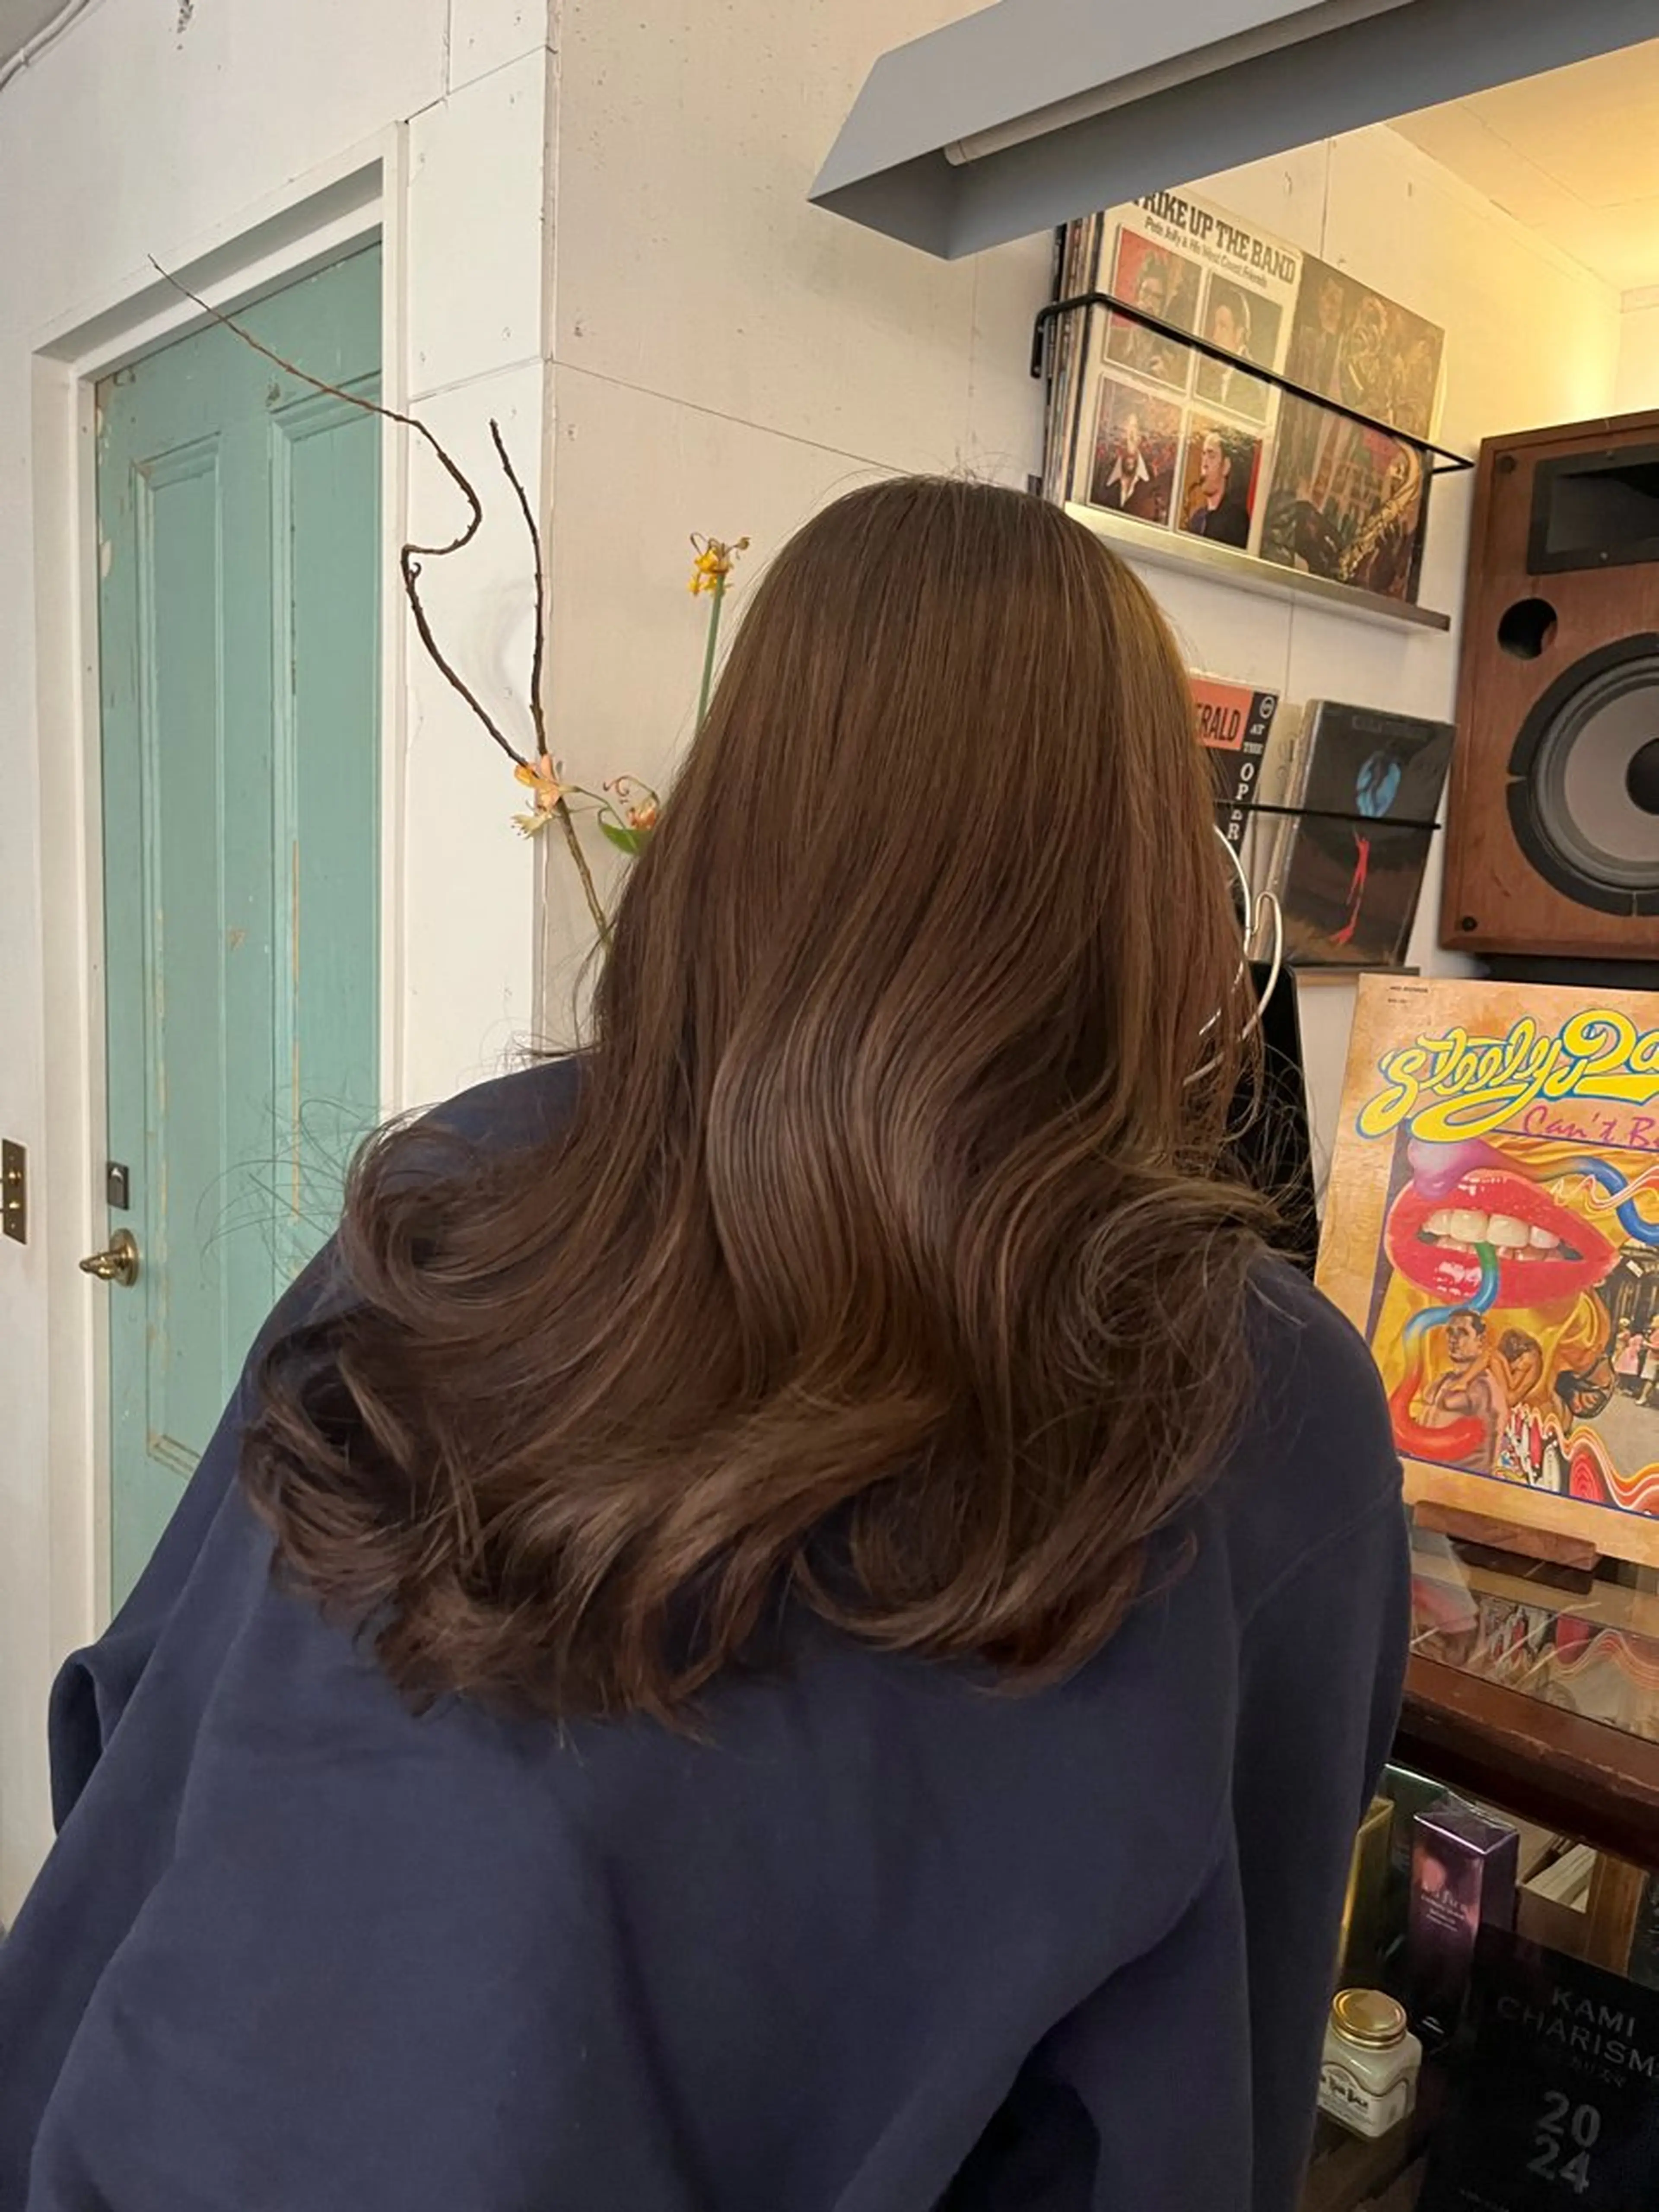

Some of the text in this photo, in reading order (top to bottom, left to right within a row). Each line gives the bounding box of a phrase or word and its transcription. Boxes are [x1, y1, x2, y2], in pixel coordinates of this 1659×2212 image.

[1134, 191, 1296, 285] RIKE UP THE BAND
[1523, 1105, 1659, 1148] Can't B
[1497, 1996, 1659, 2077] CHARISM
[1552, 1986, 1636, 2037] KAMI
[1538, 2089, 1602, 2148] 20
[1526, 2133, 1591, 2195] 24
